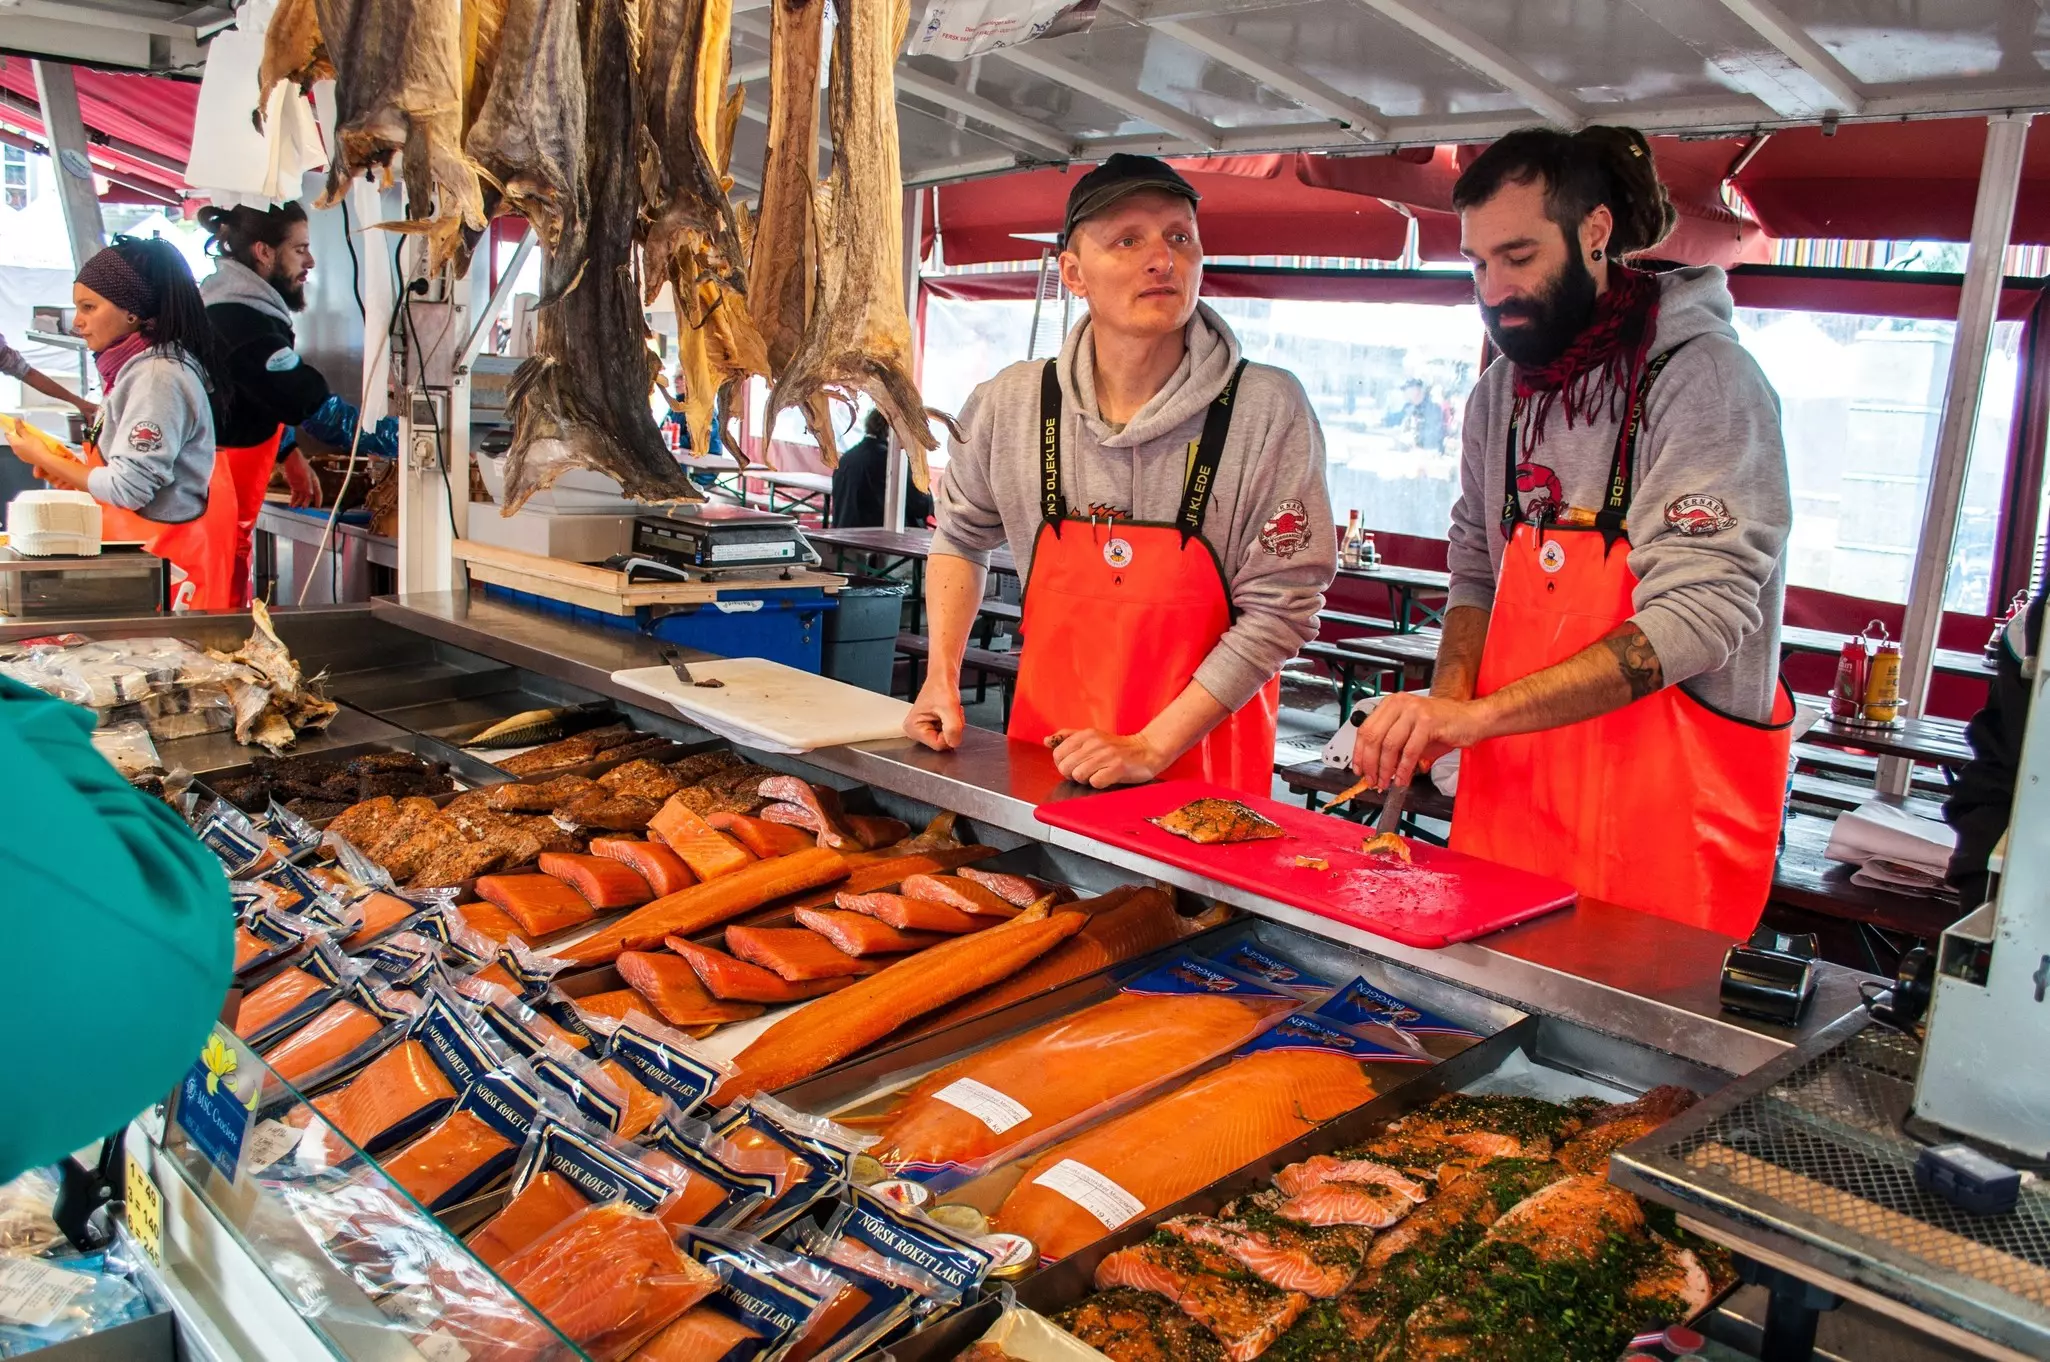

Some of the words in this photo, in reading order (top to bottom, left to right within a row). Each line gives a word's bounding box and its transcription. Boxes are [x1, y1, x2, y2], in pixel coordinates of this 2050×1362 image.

[1046, 418, 1057, 491] OLJEKLEDE
[1357, 983, 1405, 1010] BRYGGEN
[426, 1025, 451, 1052] NORSK
[445, 1047, 470, 1079] RØKET
[645, 1064, 676, 1086] RØKET
[671, 1080, 698, 1098] LAKS
[473, 1083, 498, 1109] NORSK
[497, 1103, 527, 1131] RØKET
[130, 1163, 135, 1178] 1
[145, 1184, 156, 1207] 49
[581, 1172, 619, 1199] RØKET
[128, 1186, 133, 1203] 3
[143, 1210, 159, 1240] 140
[128, 1214, 133, 1230] 6
[144, 1236, 160, 1268] 245
[858, 1215, 899, 1246] NORSK
[895, 1237, 936, 1269] RØKET
[932, 1262, 966, 1287] LAKS
[728, 1288, 767, 1316] RØKET
[764, 1307, 796, 1331] LAKS
